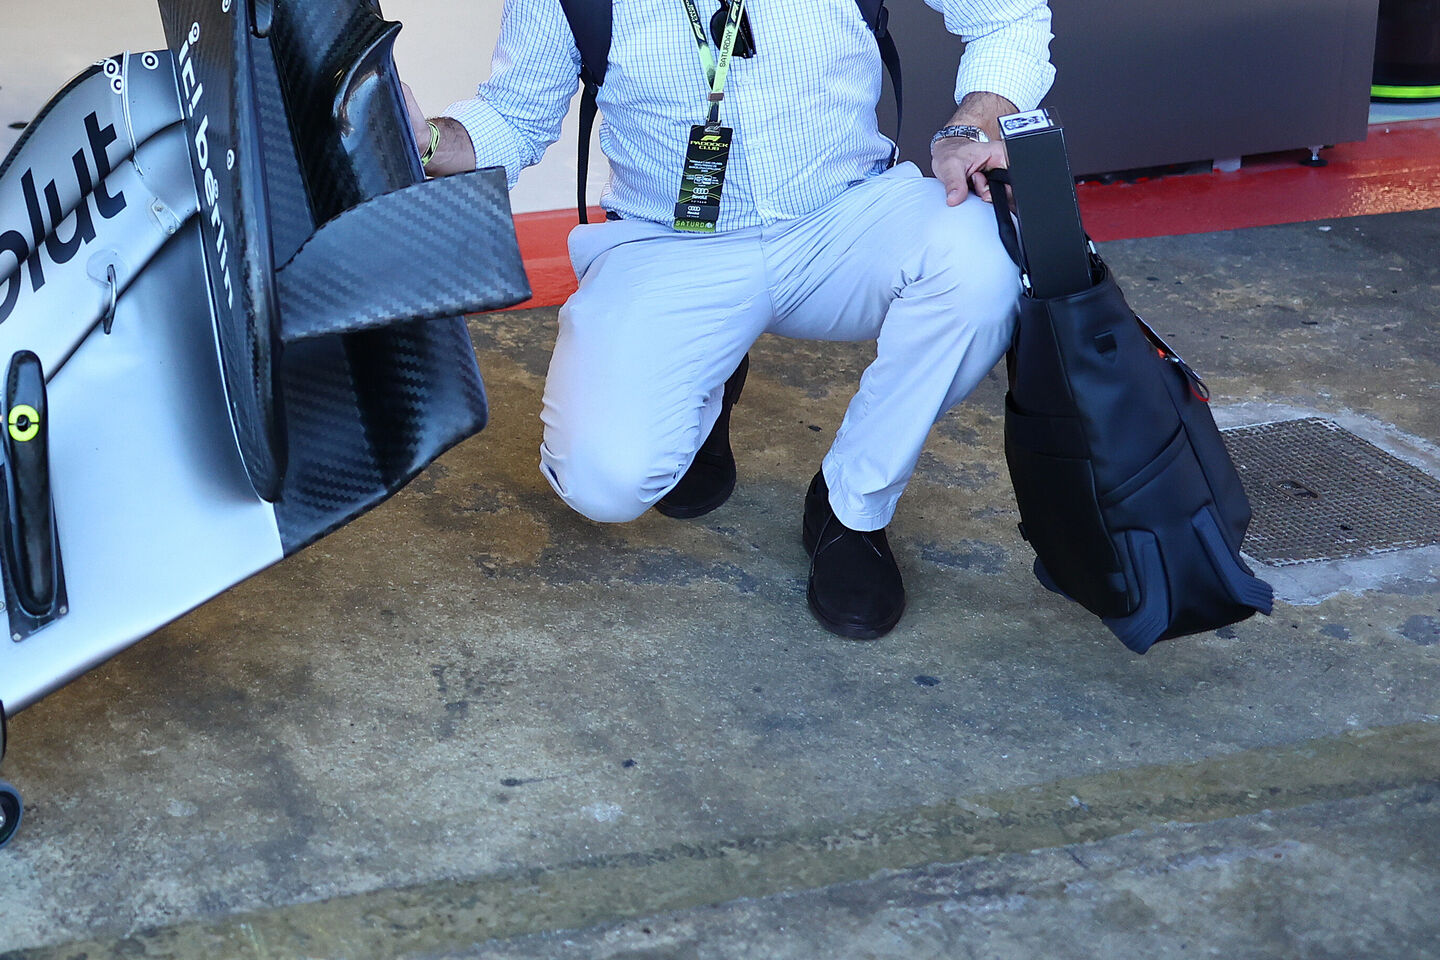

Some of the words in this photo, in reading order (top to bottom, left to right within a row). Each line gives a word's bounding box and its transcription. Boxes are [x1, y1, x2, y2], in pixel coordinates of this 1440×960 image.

[719, 30, 734, 68] SATURDAY
[690, 140, 729, 148] PADDOCK
[195, 115, 234, 310] berlin
